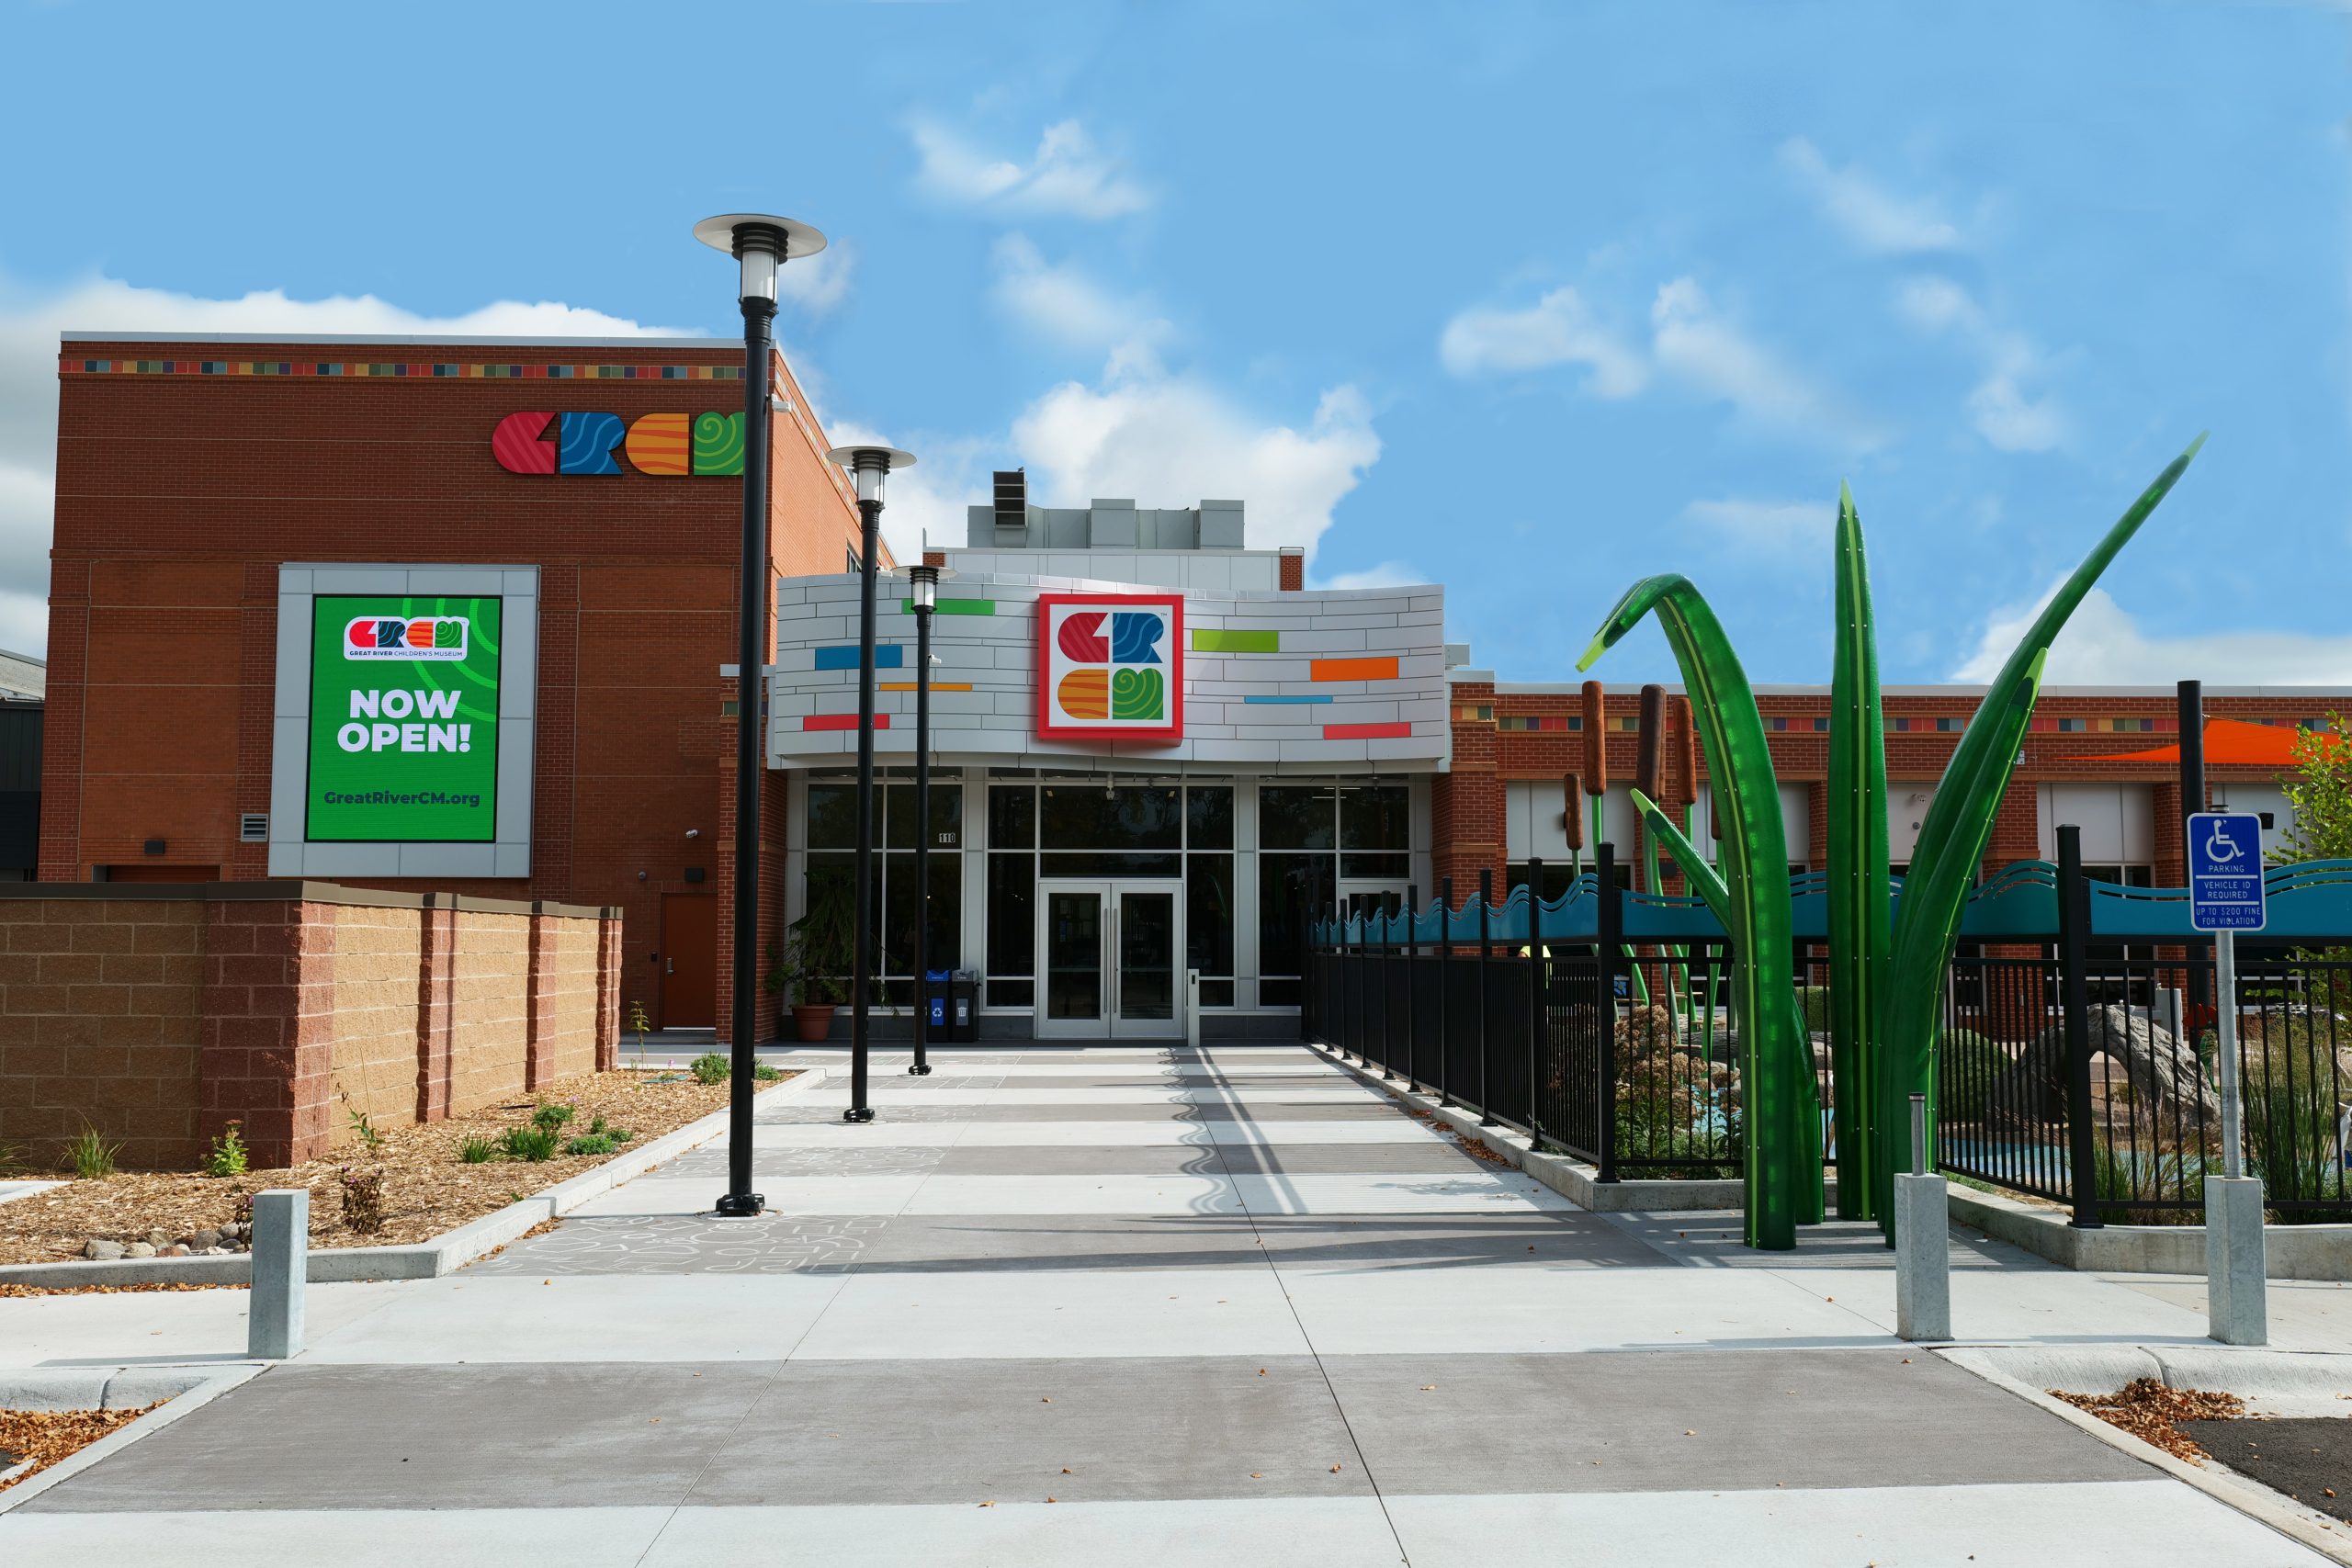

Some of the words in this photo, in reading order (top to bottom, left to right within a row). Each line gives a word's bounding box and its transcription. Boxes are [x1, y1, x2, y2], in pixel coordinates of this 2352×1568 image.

[350, 689, 461, 719] NOW
[337, 722, 471, 752] OPEN!
[323, 790, 481, 807] GreatRiverCM.org
[939, 833, 956, 842] 110
[2204, 881, 2238, 889] VEHICLE
[2242, 881, 2251, 889] ID
[2207, 891, 2248, 899] REQUIRED
[2196, 908, 2206, 916] UP
[2209, 908, 2217, 916] TO
[2221, 907, 2241, 916] $200
[2245, 907, 2261, 916] FINE
[2202, 918, 2216, 926] FOR
[2219, 917, 2256, 925] VIOLATION
